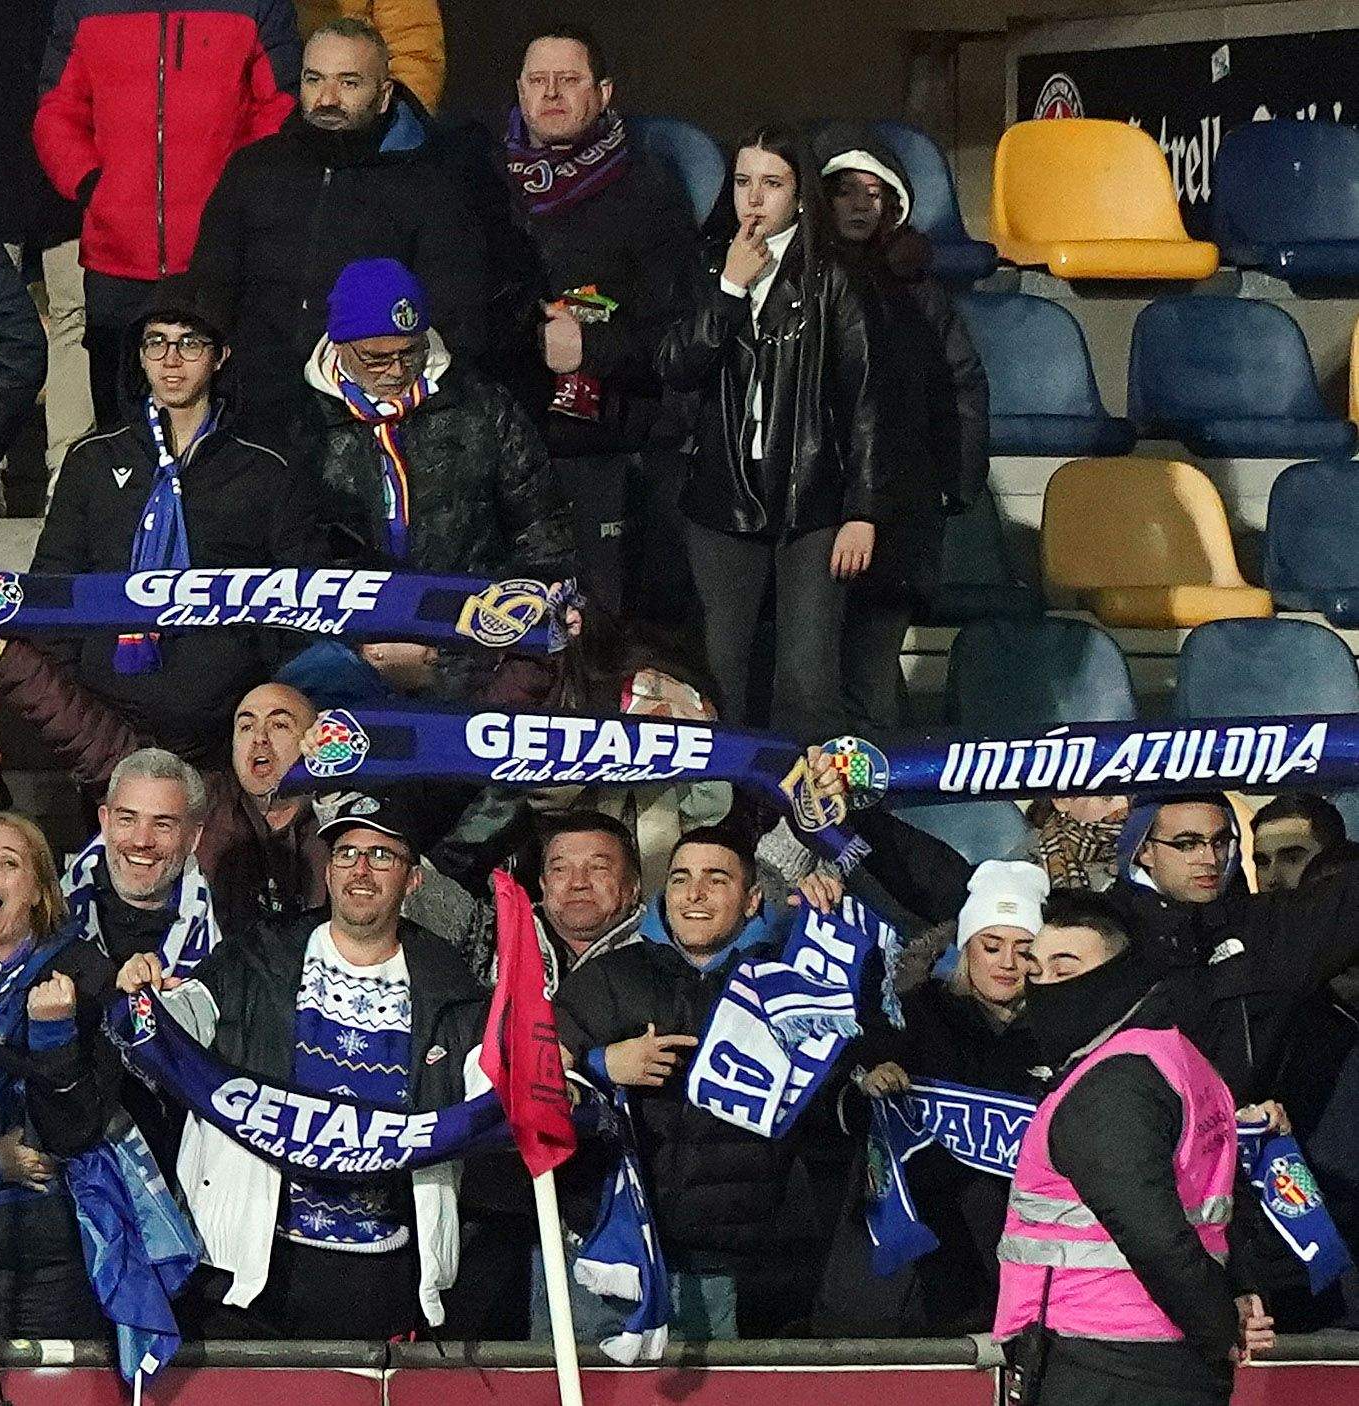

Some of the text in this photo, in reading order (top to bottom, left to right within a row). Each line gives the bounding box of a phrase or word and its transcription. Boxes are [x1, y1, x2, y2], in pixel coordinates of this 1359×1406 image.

[125, 568, 392, 611] GETAFE
[156, 604, 220, 627] Club
[465, 712, 714, 770] GETAFE
[1085, 722, 1329, 791] AZULONA
[491, 757, 553, 782] Club
[553, 761, 586, 782] de
[210, 1077, 438, 1149] GETAFE
[235, 1123, 414, 1174] Club de Fútbol
